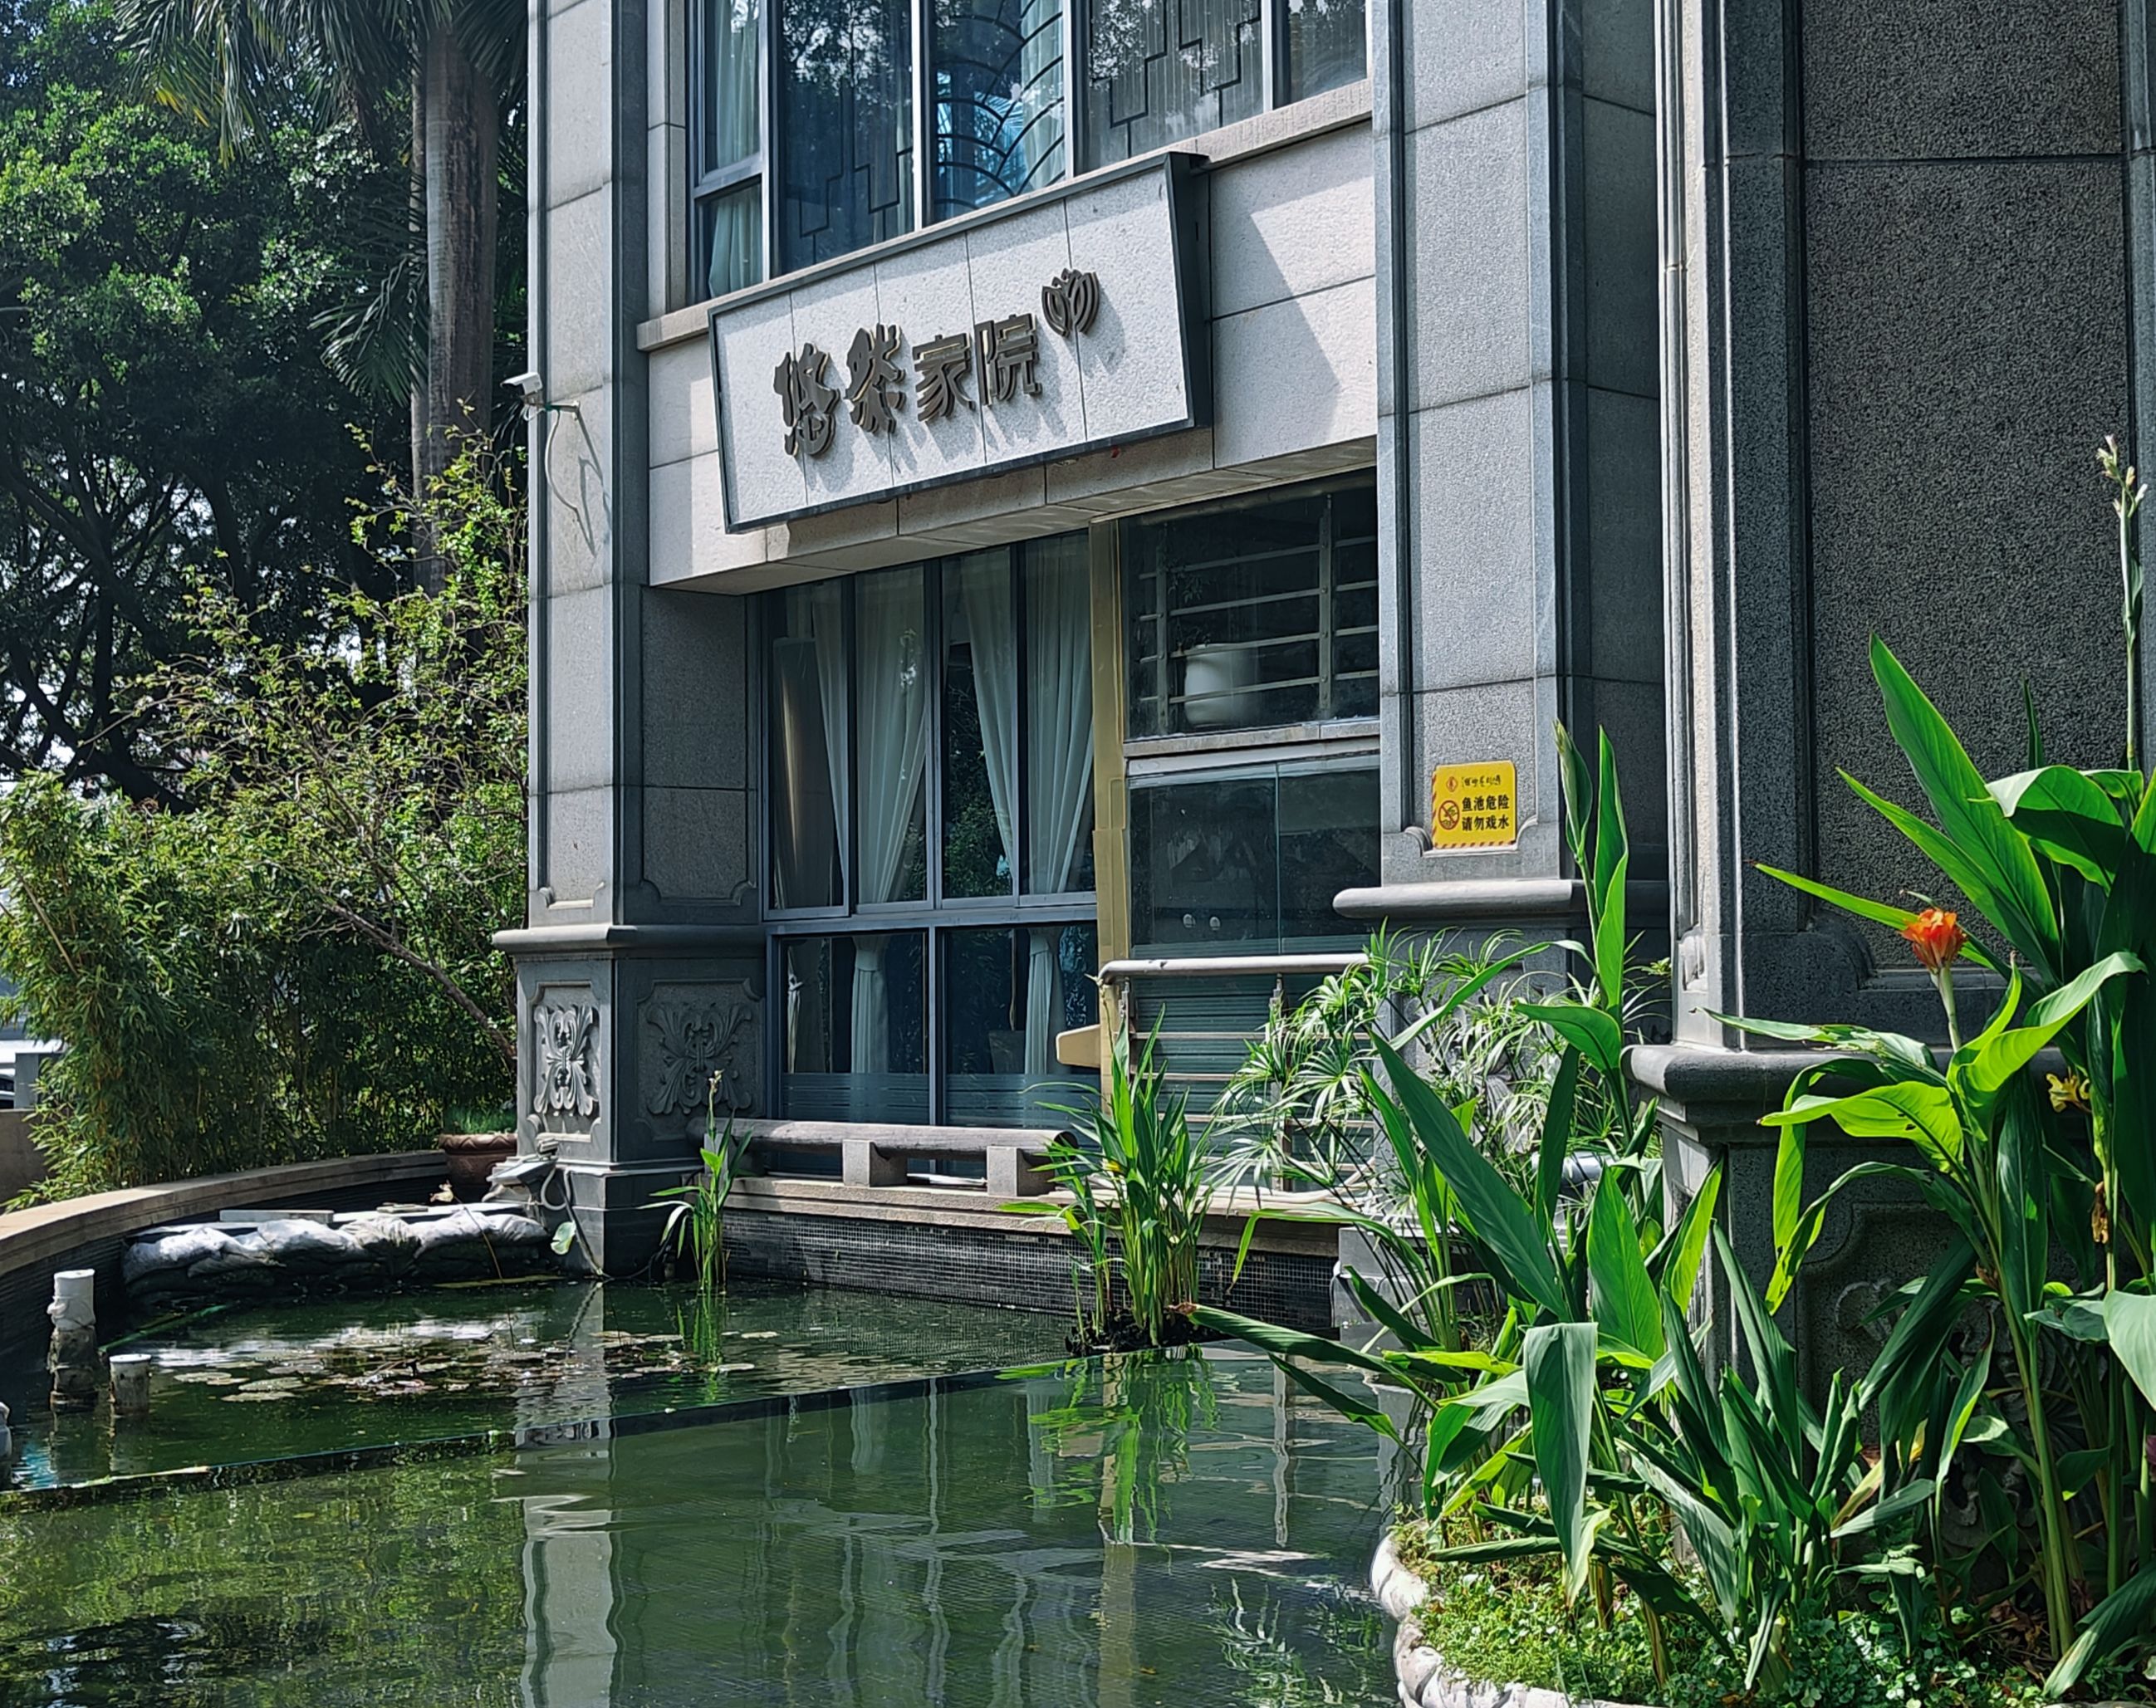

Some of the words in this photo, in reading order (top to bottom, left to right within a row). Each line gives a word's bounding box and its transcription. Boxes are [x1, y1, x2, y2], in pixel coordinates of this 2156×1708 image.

[773, 312, 1043, 458] 悠然家院
[1462, 795, 1509, 812] 鱼池危险
[1462, 815, 1509, 831] 请勿戏水
